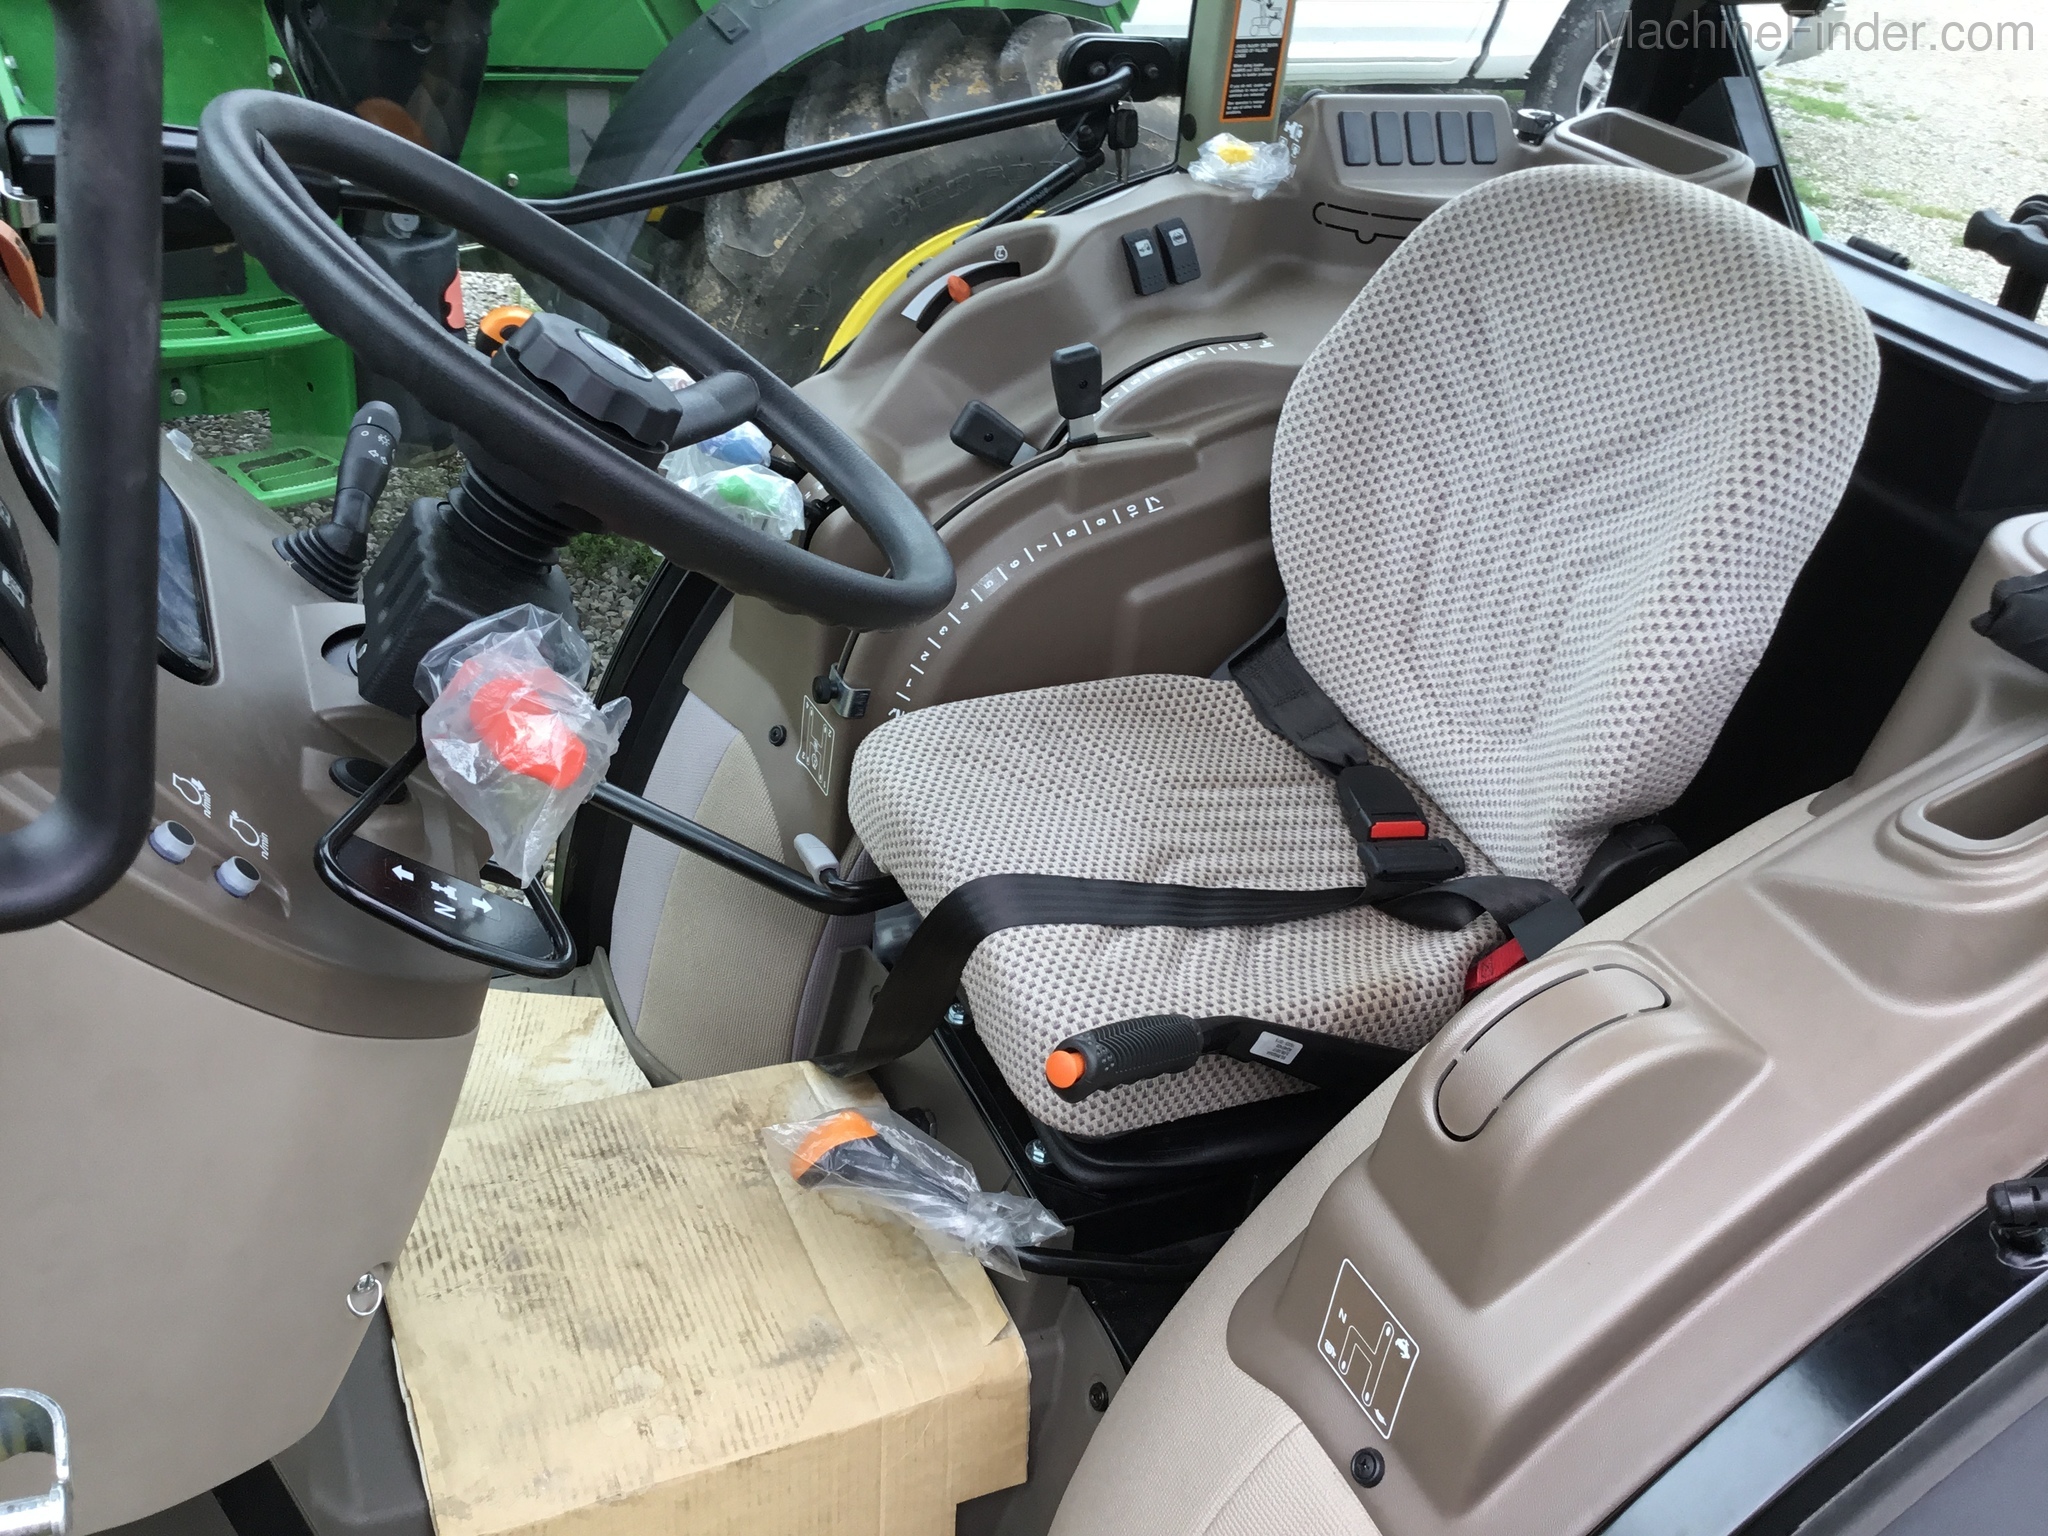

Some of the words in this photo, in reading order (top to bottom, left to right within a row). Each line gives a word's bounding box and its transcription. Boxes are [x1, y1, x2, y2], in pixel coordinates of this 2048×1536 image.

[920, 651, 931, 662] 2
[938, 626, 949, 636] 3
[960, 601, 970, 611] 4
[982, 579, 994, 590] 5
[1066, 528, 1077, 538] 8
[1125, 504, 1138, 518] 10
[202, 791, 212, 819] n/min
[260, 832, 269, 860] n/min
[434, 900, 457, 920] N
[1338, 1307, 1348, 1324] N
